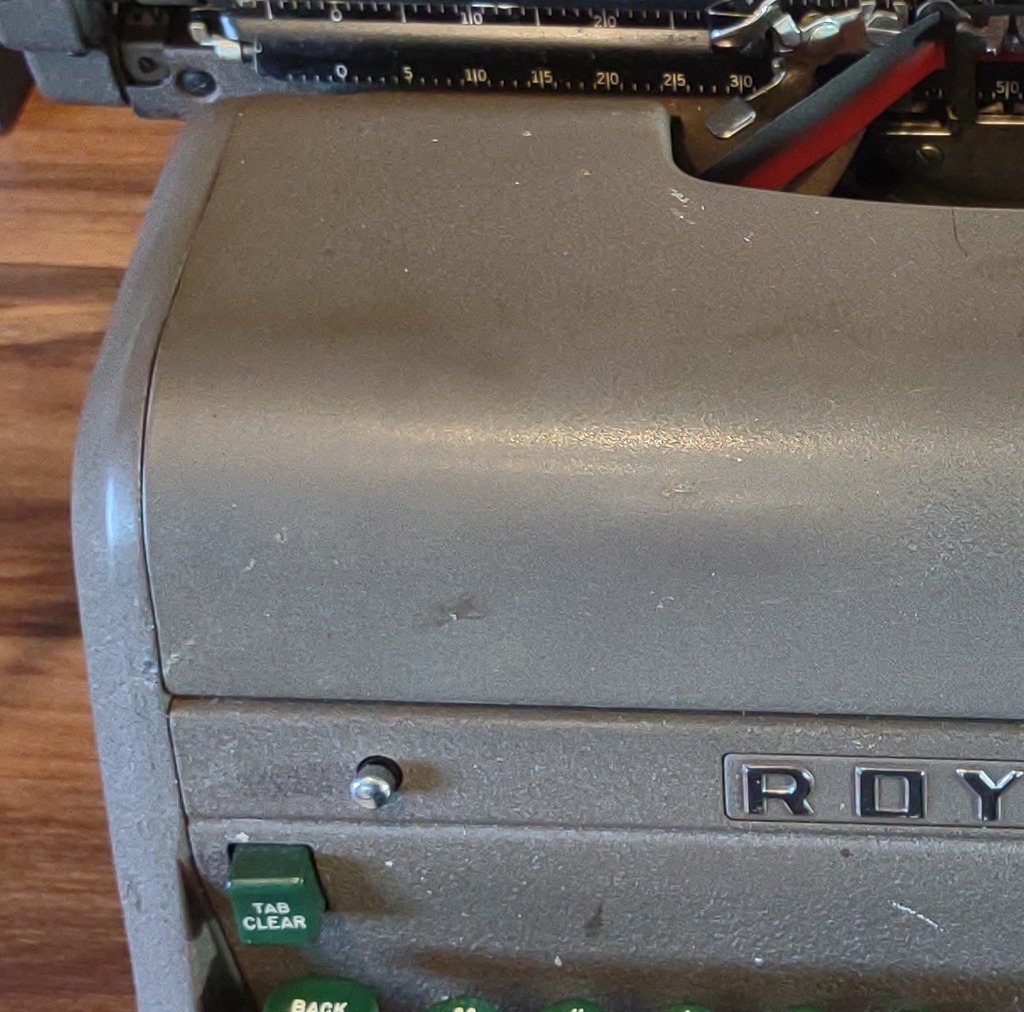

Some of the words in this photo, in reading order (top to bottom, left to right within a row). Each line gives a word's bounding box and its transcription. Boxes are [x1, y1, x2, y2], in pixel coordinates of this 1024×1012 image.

[460, 12, 483, 26] 10
[594, 14, 616, 29] 20
[336, 65, 348, 79] 0
[403, 66, 413, 80] 5
[464, 68, 488, 84] 10
[531, 70, 553, 86] 15
[596, 71, 620, 87] 20
[663, 73, 686, 89] 25
[729, 74, 753, 93] 30
[995, 80, 1020, 99] 50
[251, 901, 291, 915] TAB
[242, 915, 307, 931] CLEAR
